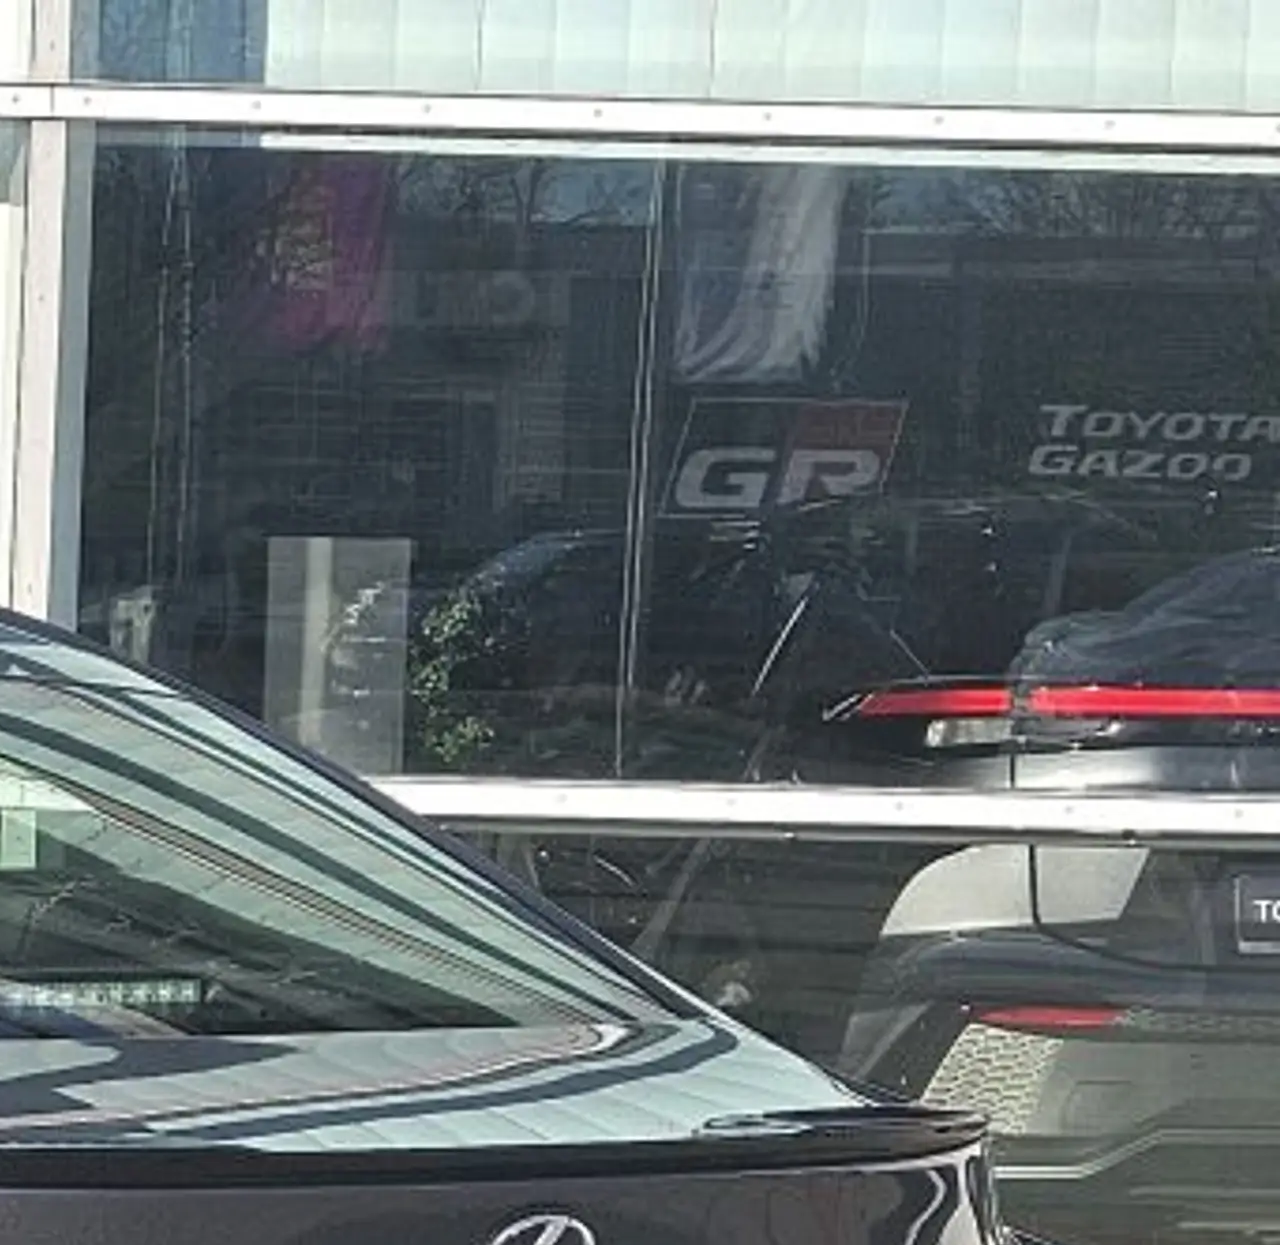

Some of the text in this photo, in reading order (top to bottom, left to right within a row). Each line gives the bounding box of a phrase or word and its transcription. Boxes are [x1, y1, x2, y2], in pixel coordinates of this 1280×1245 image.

[1040, 404, 1280, 442] TOYOTA
[674, 448, 882, 509] GR
[1028, 443, 1252, 481] GAZOO
